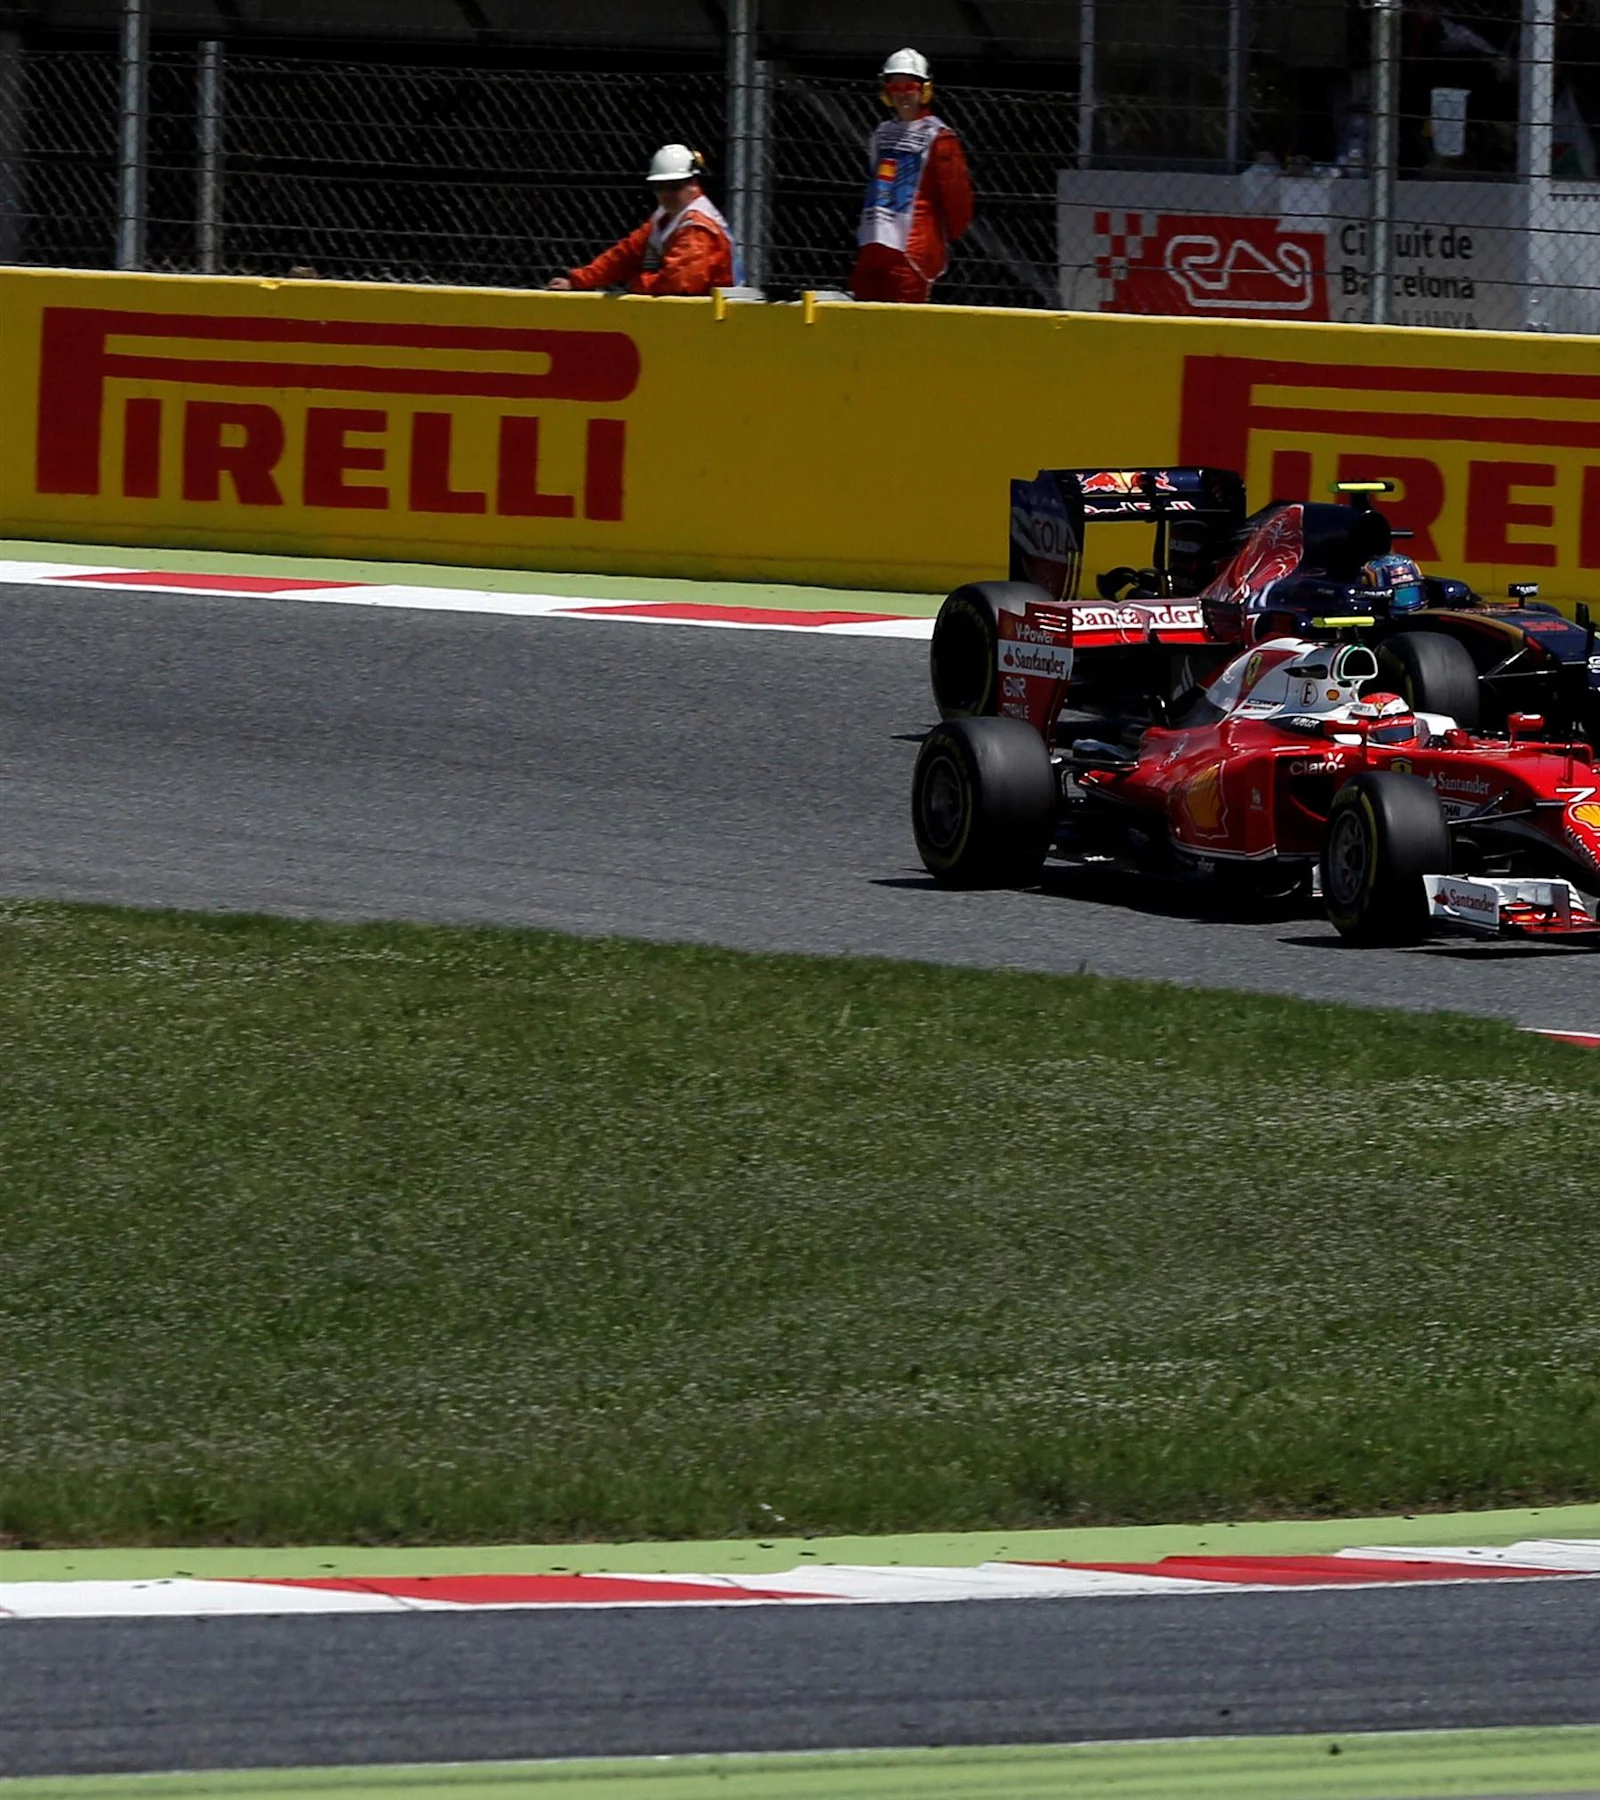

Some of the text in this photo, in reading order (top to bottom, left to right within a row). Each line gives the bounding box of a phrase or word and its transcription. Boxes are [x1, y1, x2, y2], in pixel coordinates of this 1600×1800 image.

[1340, 222, 1474, 259] Ciuit de
[1341, 265, 1475, 299] Baelona
[36, 306, 641, 521] PIRELLI
[1072, 604, 1201, 627] Santander
[1015, 622, 1055, 645] V-Power
[1014, 647, 1065, 674] Santander
[1437, 770, 1491, 796] Santander
[1555, 787, 1597, 804] 7
[1448, 888, 1496, 913] Santander
